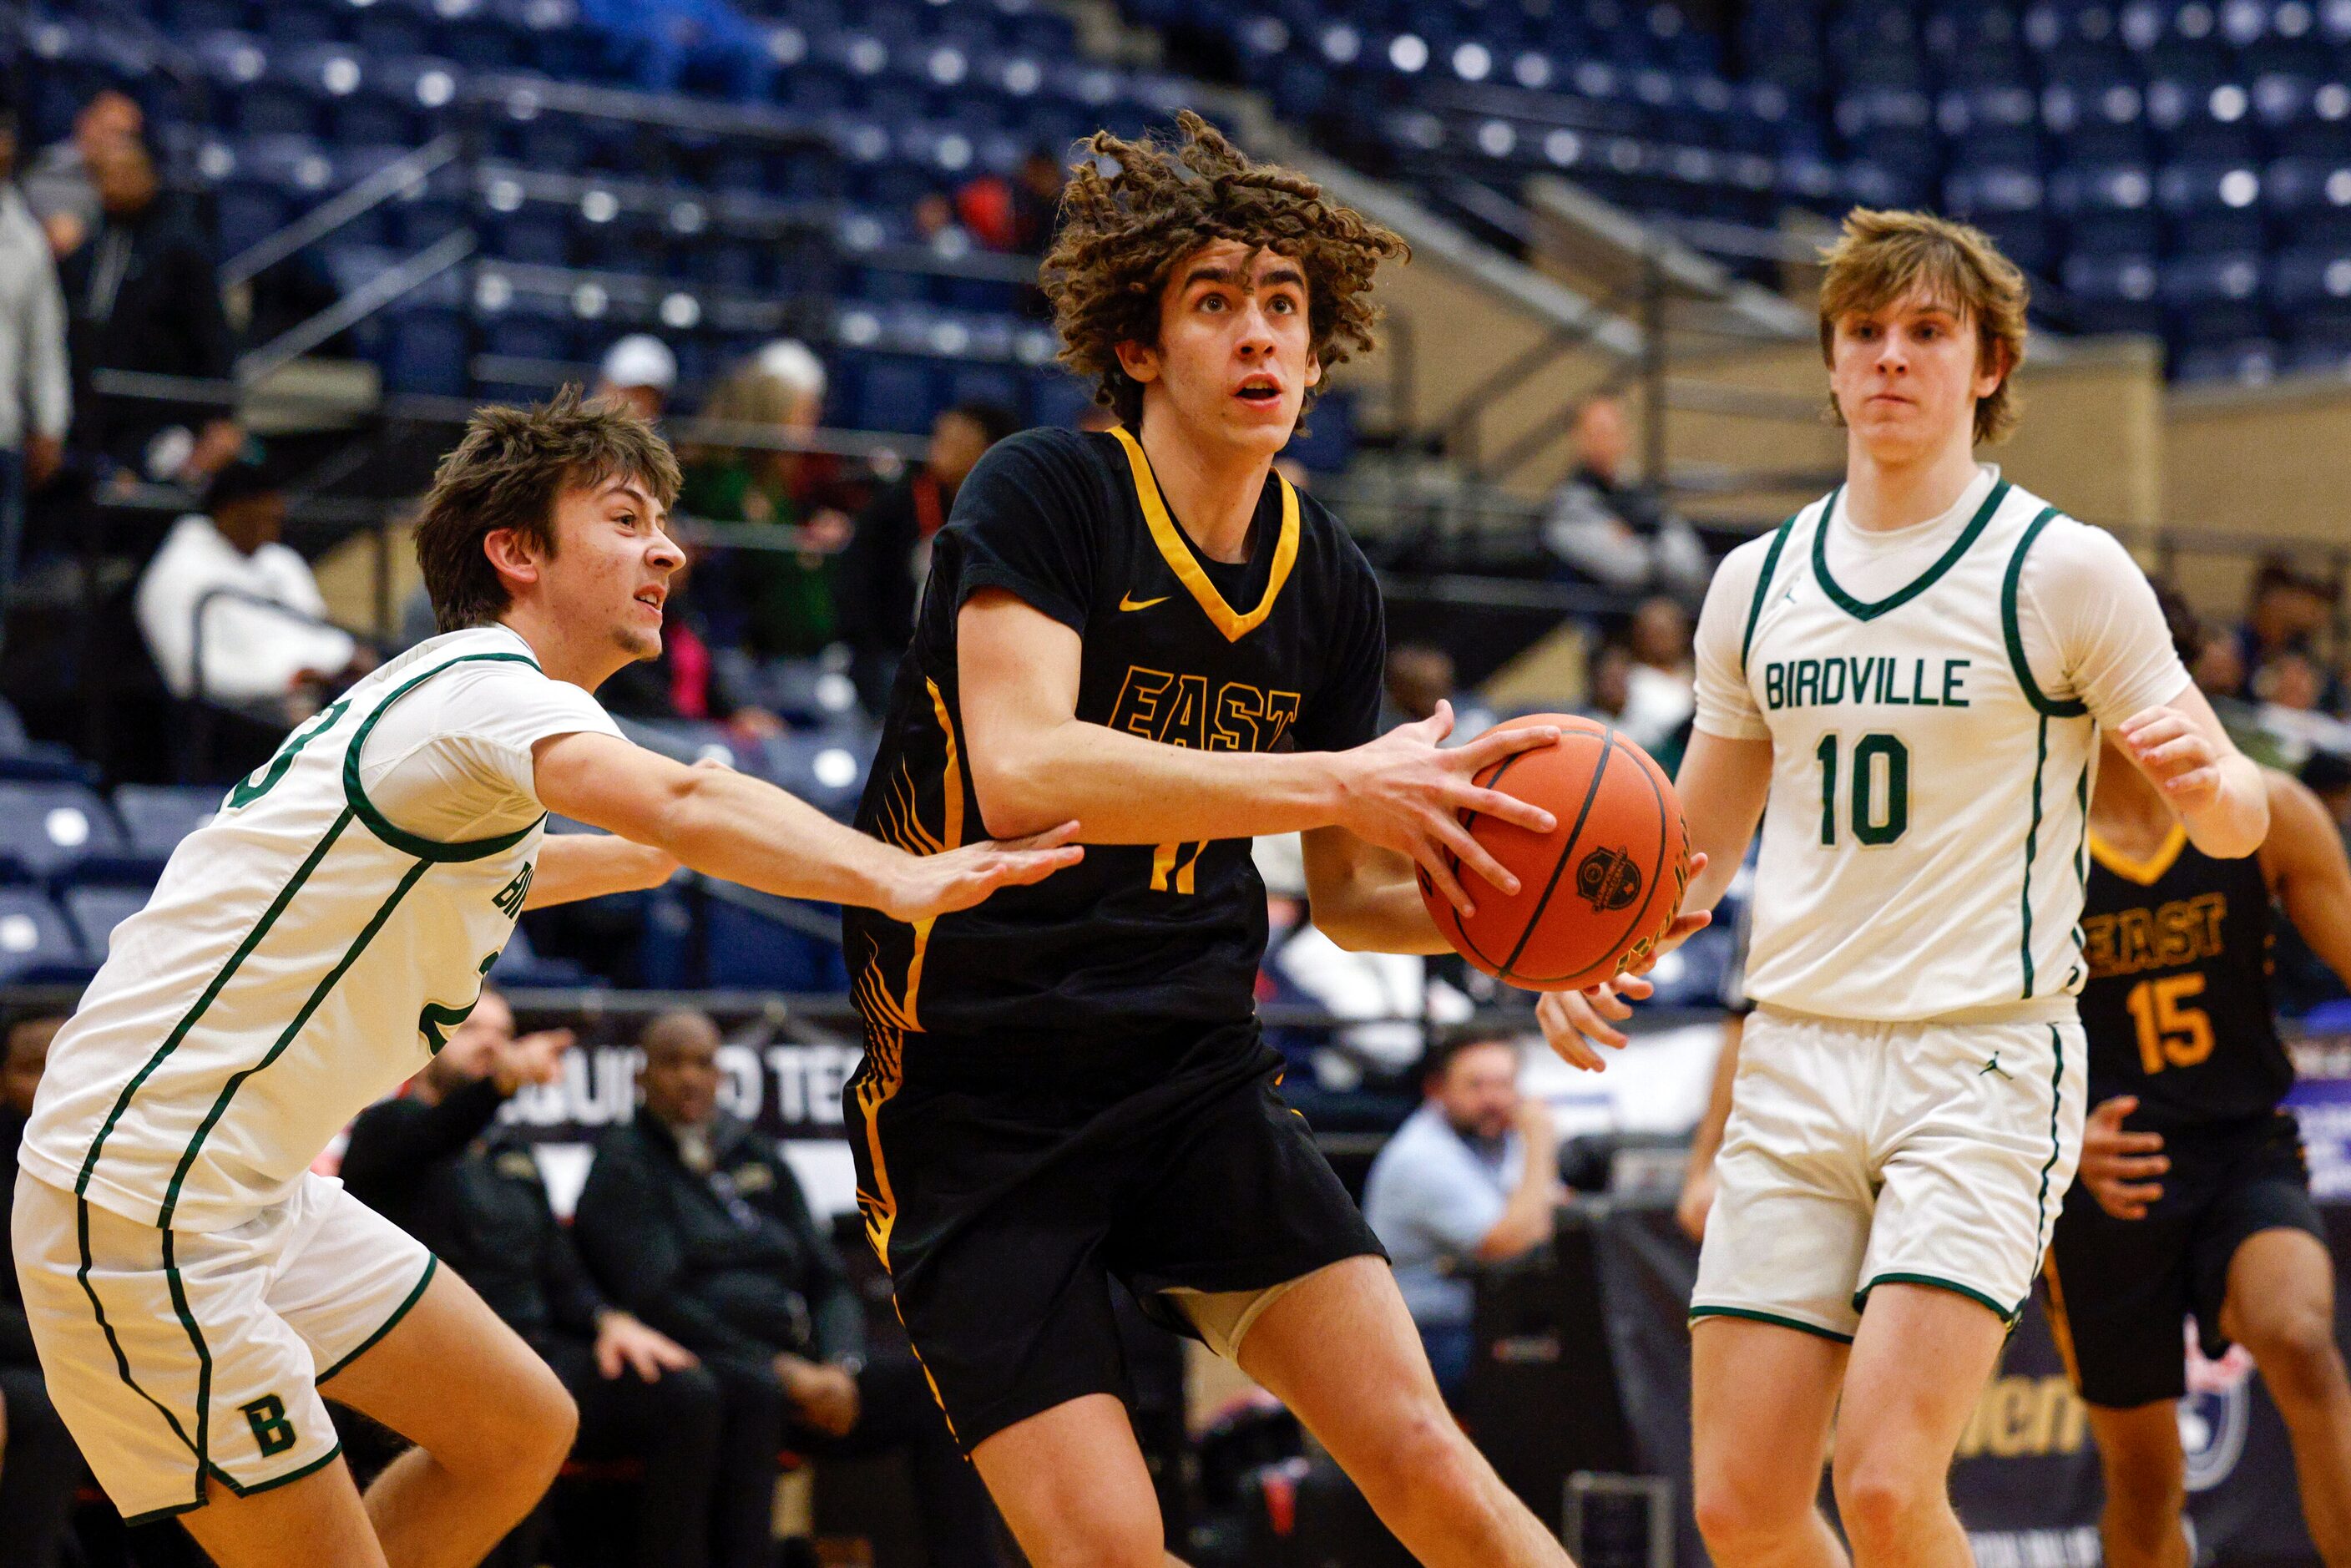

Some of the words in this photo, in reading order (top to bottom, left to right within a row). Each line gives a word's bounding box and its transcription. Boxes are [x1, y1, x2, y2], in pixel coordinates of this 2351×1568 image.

[1107, 665, 1302, 752] EAST
[1765, 656, 1971, 710] BIRDVILLE
[1816, 733, 1909, 846] 10
[2081, 891, 2227, 979] EAST
[2126, 971, 2217, 1075] 15
[237, 1393, 297, 1459] B
